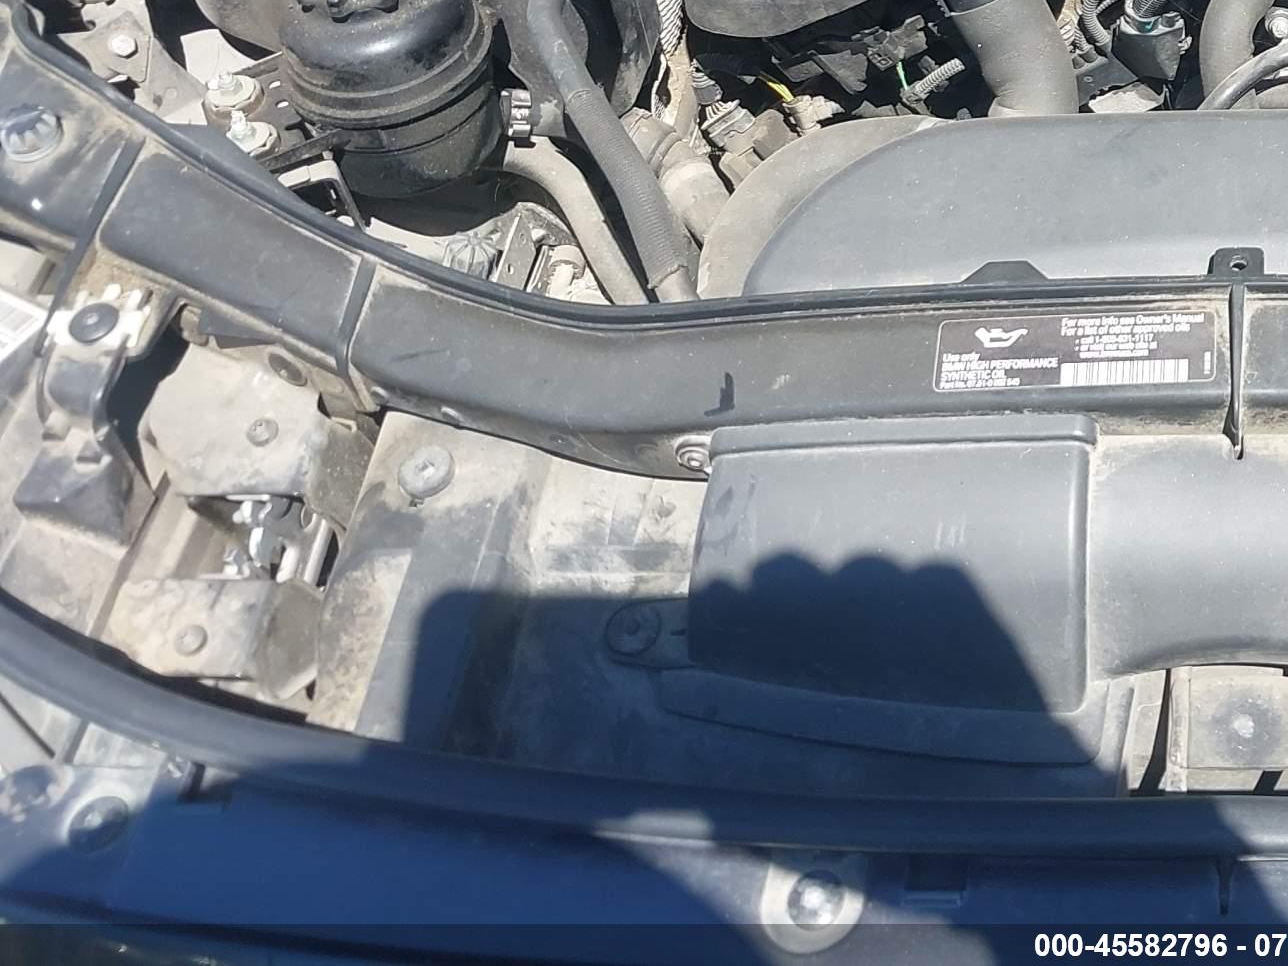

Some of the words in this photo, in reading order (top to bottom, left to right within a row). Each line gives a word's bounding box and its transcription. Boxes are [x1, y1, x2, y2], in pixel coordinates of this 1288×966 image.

[1061, 318, 1077, 327] For
[1102, 316, 1118, 326] info
[1136, 314, 1171, 325] Owner's
[1172, 313, 1205, 324] Manual
[1061, 326, 1077, 336] For
[1098, 324, 1109, 334] of
[943, 353, 960, 362] Use
[961, 351, 981, 363] only
[967, 360, 989, 371] HIGH
[990, 357, 1059, 370] PERFORMANCE
[940, 369, 992, 382] SYNTHETIC
[992, 369, 1006, 379] OIL
